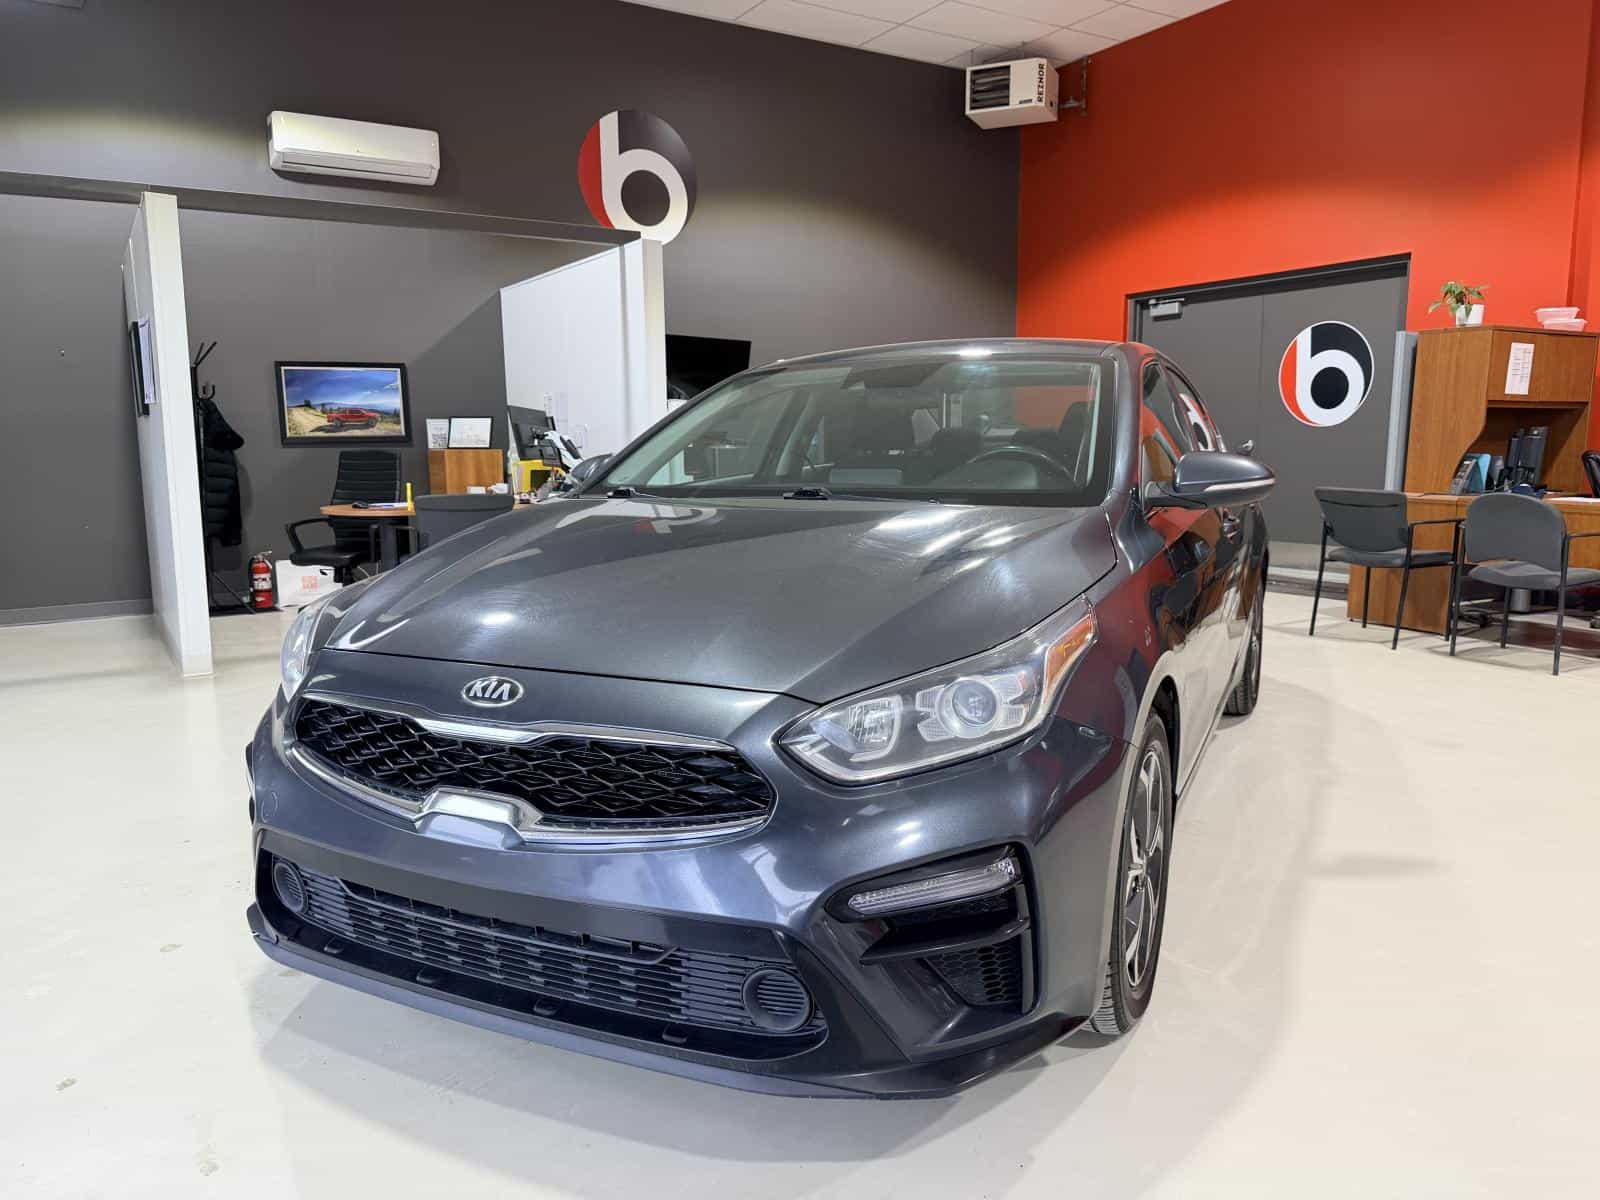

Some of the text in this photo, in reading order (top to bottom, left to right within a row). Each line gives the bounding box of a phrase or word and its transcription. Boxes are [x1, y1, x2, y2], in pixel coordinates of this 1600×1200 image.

[1037, 63, 1045, 103] REZNOR
[599, 109, 688, 246] b
[1296, 326, 1365, 427] b
[468, 680, 511, 701] KIA
